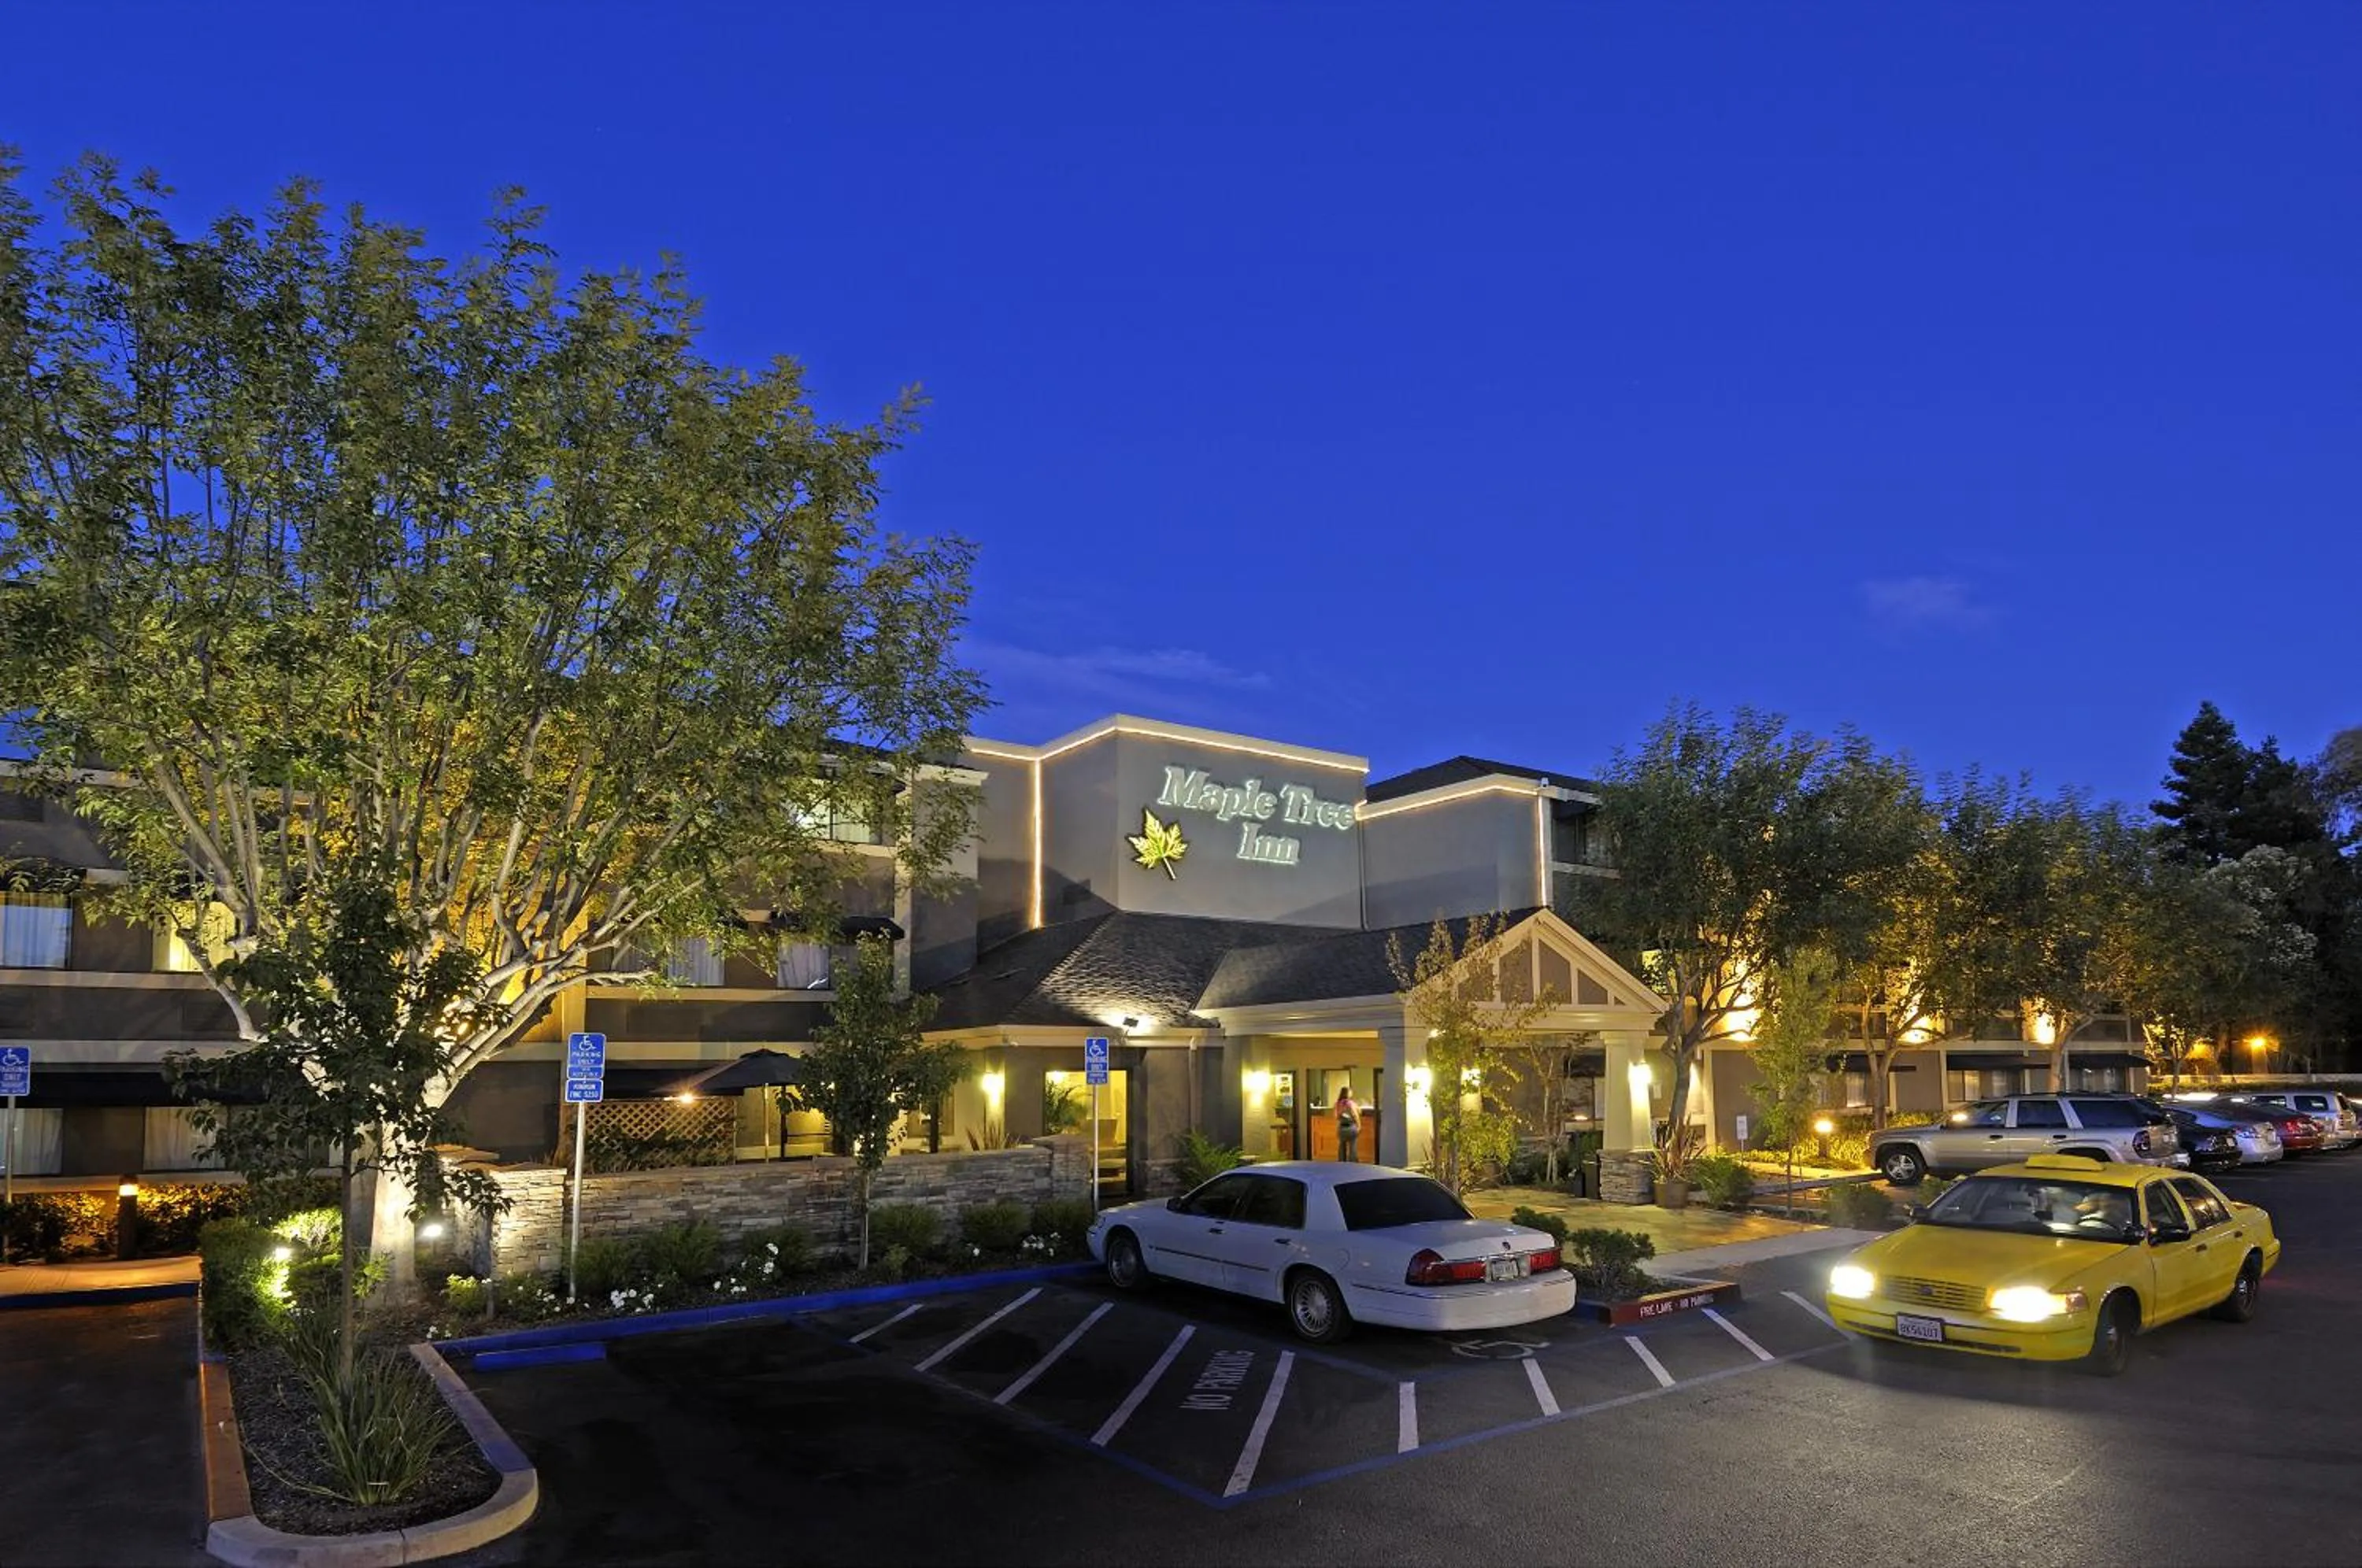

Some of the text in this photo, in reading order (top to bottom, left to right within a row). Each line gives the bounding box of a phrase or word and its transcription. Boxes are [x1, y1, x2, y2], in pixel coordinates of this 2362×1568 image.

[1157, 765, 1356, 830] Maple Tree
[1237, 821, 1300, 865] Inn
[1640, 1304, 1656, 1318] FIRE
